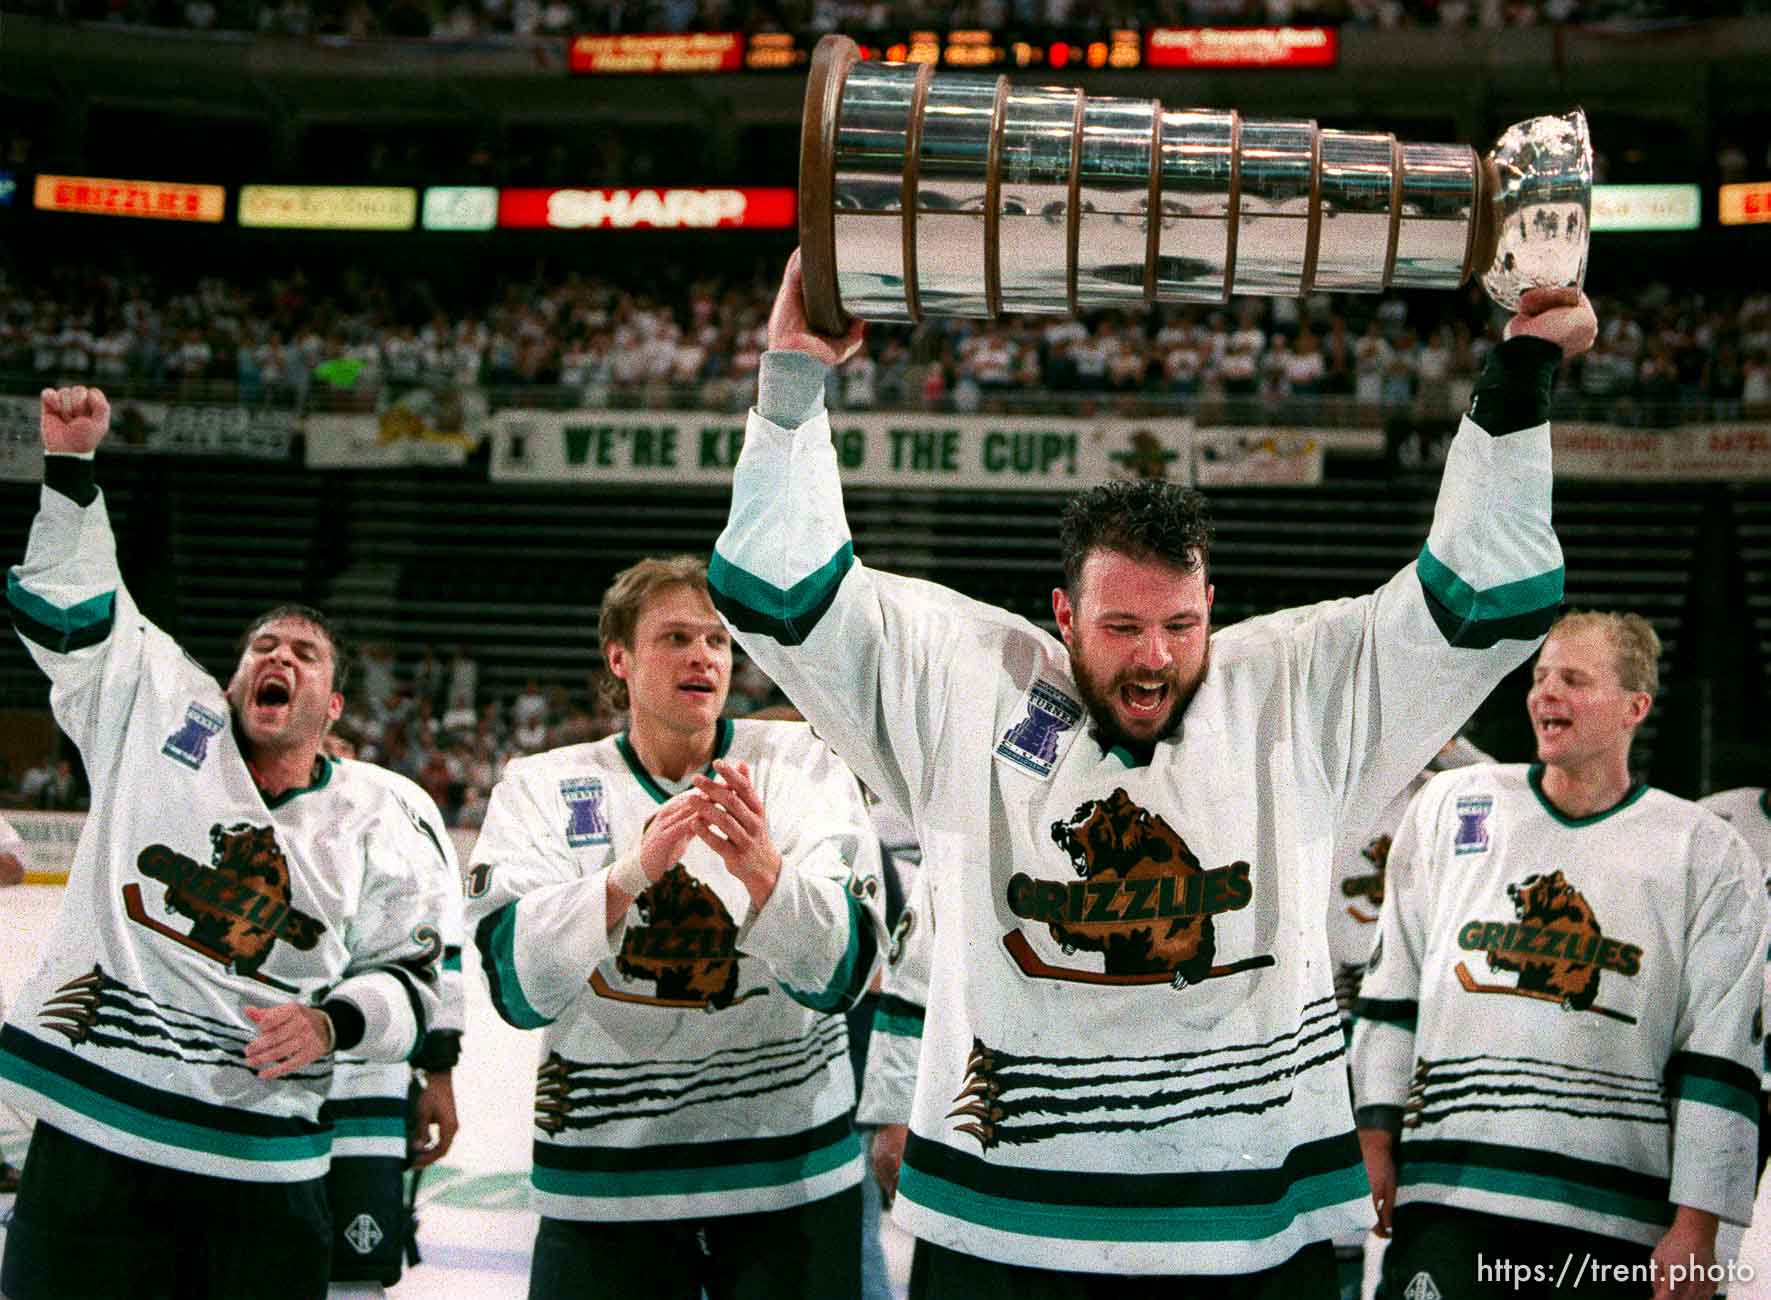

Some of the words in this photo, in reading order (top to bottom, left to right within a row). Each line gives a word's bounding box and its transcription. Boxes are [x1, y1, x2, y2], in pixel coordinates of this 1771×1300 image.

[547, 189, 747, 229] SHARP
[565, 425, 678, 467] WE'RE
[888, 428, 960, 472] THE
[983, 430, 1078, 476] CUP!
[1007, 860, 1252, 924] GRIZZLIES
[1458, 920, 1644, 977] GRIZZLIES
